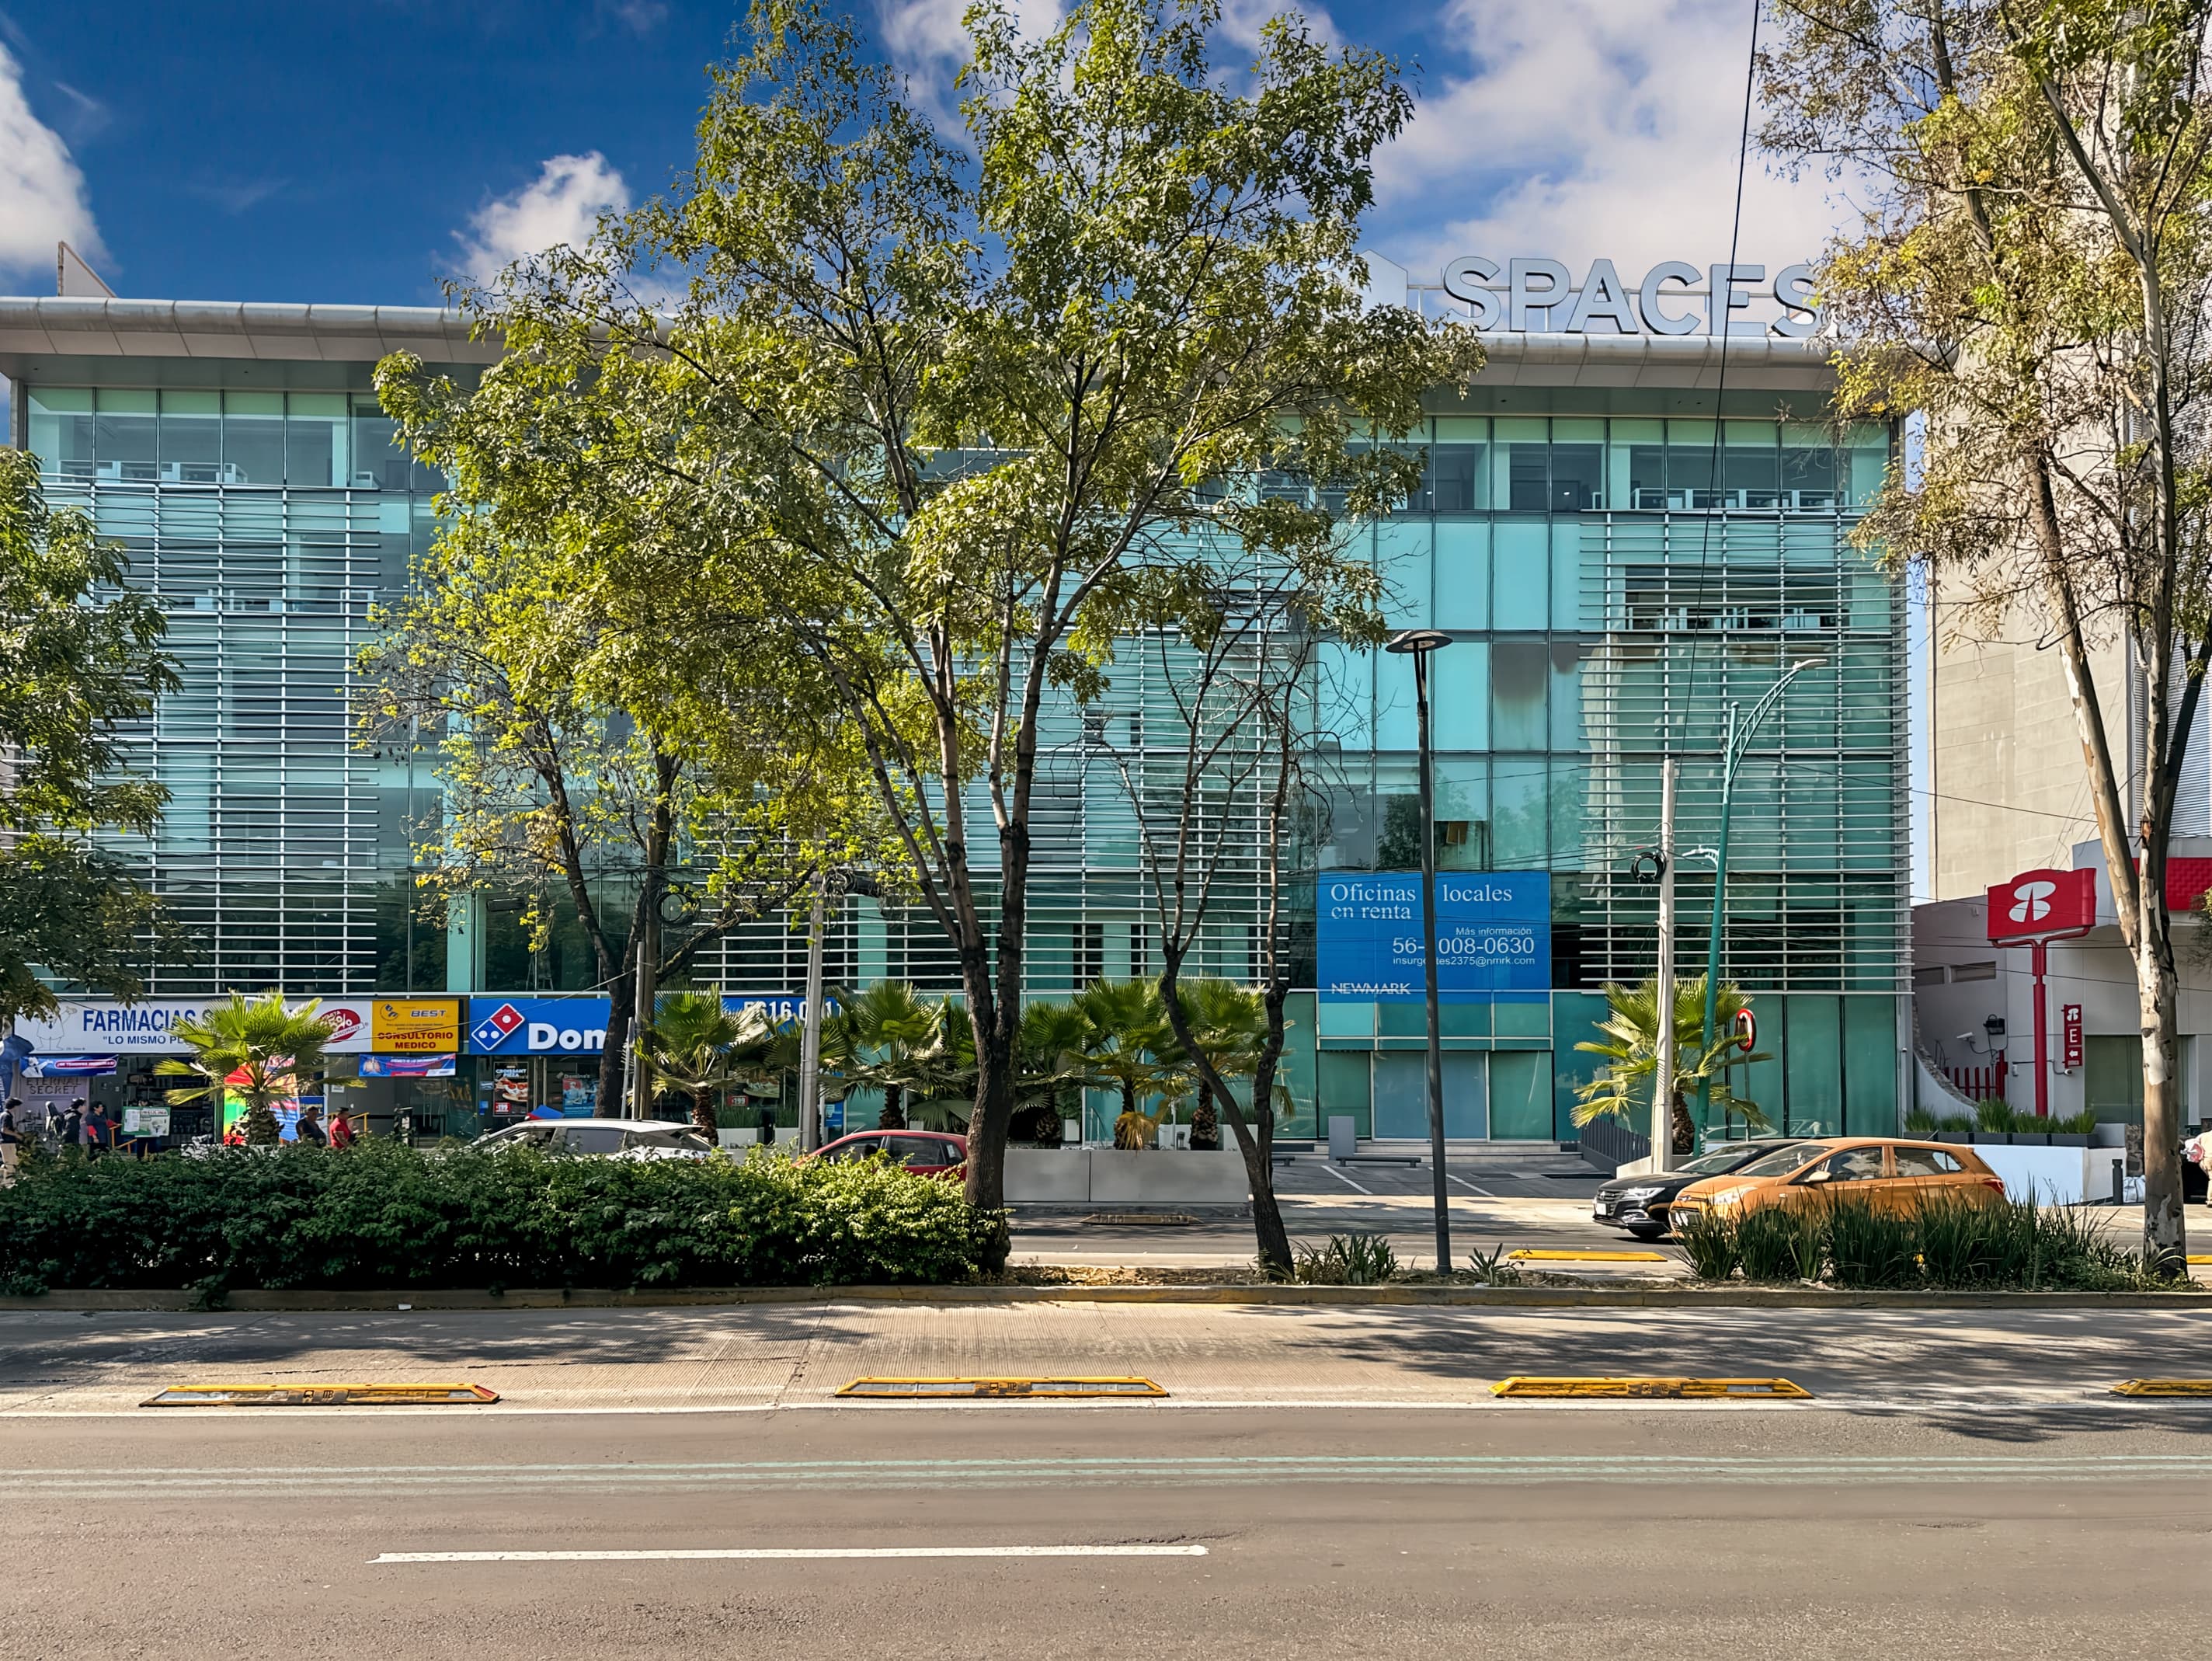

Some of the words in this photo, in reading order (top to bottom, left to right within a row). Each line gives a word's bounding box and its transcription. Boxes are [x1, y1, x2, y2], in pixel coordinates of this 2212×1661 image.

[1443, 256, 1823, 337] SPACES
[1330, 883, 1416, 902] Oficinas
[1442, 884, 1513, 902] locales
[1330, 906, 1354, 920] en
[1362, 904, 1411, 920] renta
[1456, 927, 1476, 935] Más
[1392, 937, 1535, 955] 56-008-0630
[1393, 956, 1536, 967] insurgtes2375@nmrk.com
[1331, 983, 1411, 994] NEWMARK
[410, 1009, 447, 1018] BEST
[83, 1009, 196, 1032] FARMACIAS
[127, 1036, 166, 1045] MISMO
[2069, 1028, 2078, 1043] E
[30, 1085, 78, 1094] SECRET
